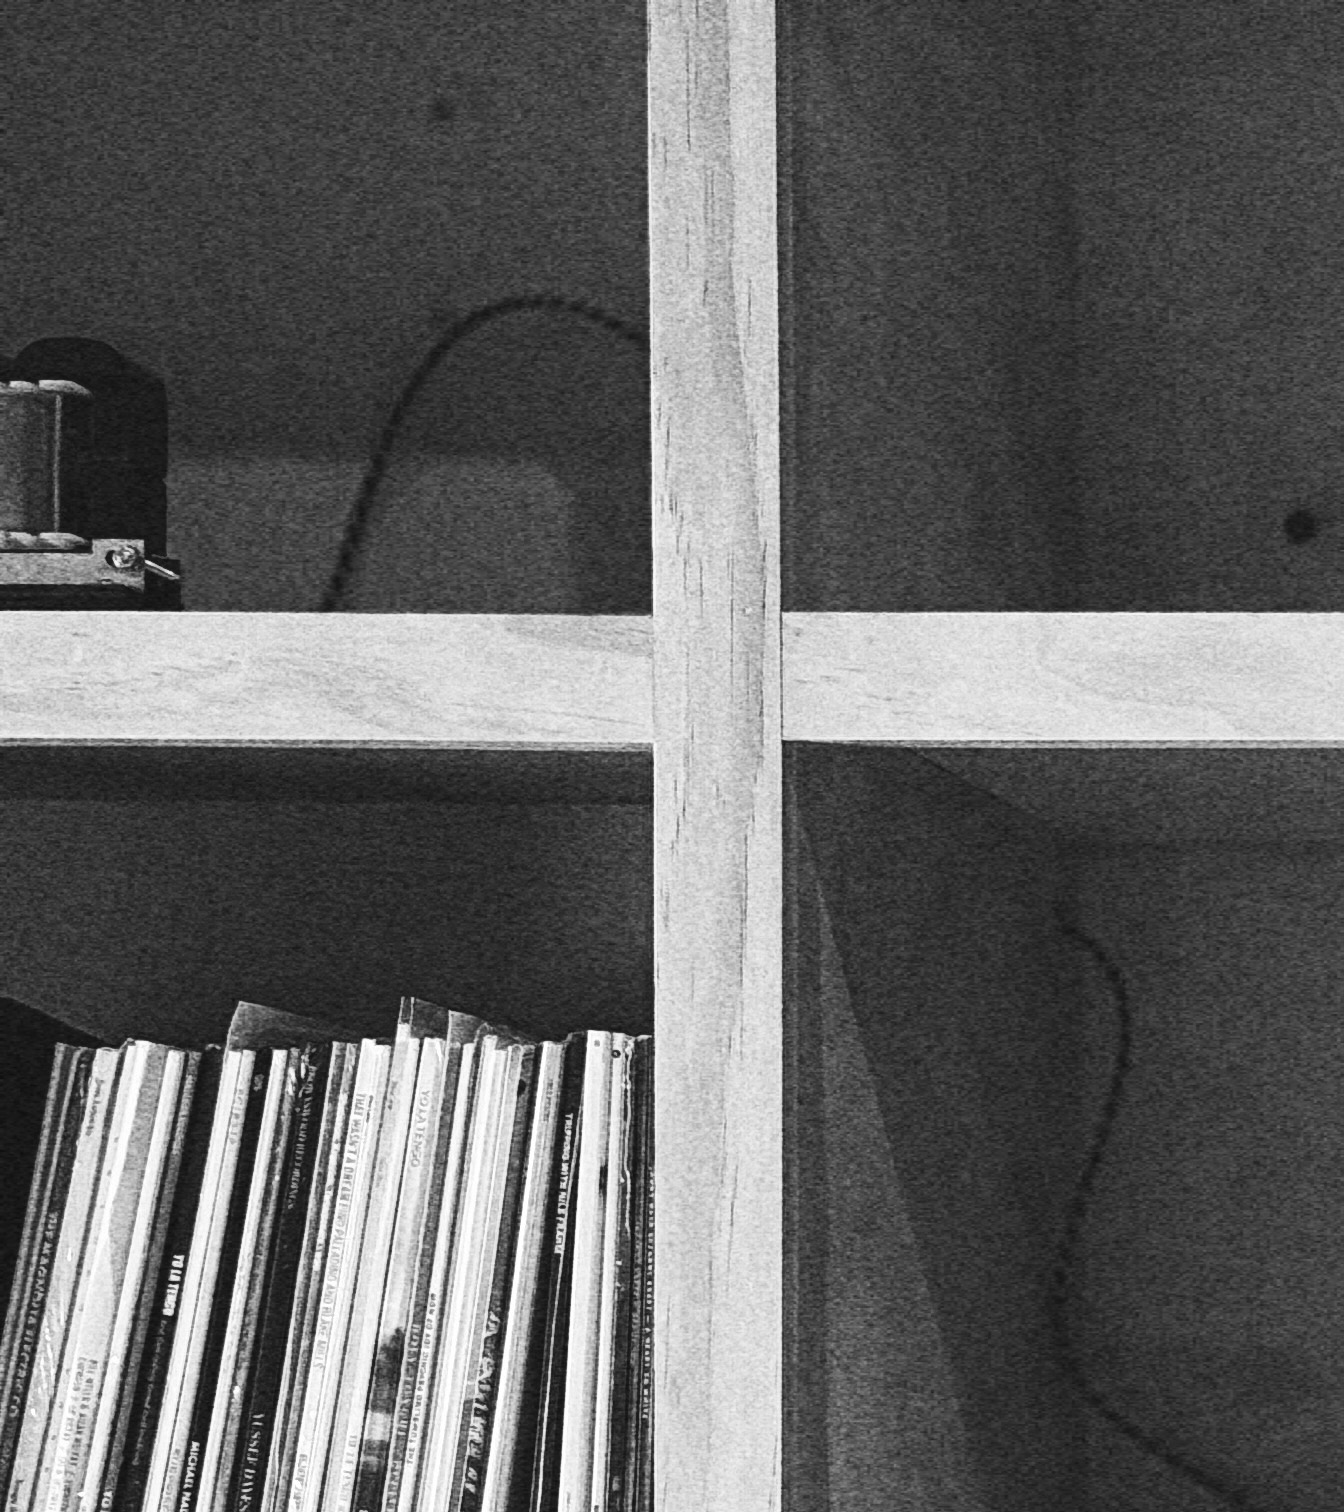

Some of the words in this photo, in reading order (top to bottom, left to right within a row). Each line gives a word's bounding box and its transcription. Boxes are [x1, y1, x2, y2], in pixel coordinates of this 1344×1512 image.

[417, 1088, 431, 1106] YO
[415, 1108, 428, 1124] LA
[409, 1126, 425, 1168] TENGO
[170, 1254, 184, 1269] YO
[167, 1268, 181, 1283] LA
[160, 1283, 178, 1316] TENGO
[181, 1440, 199, 1489] MICHAEL
